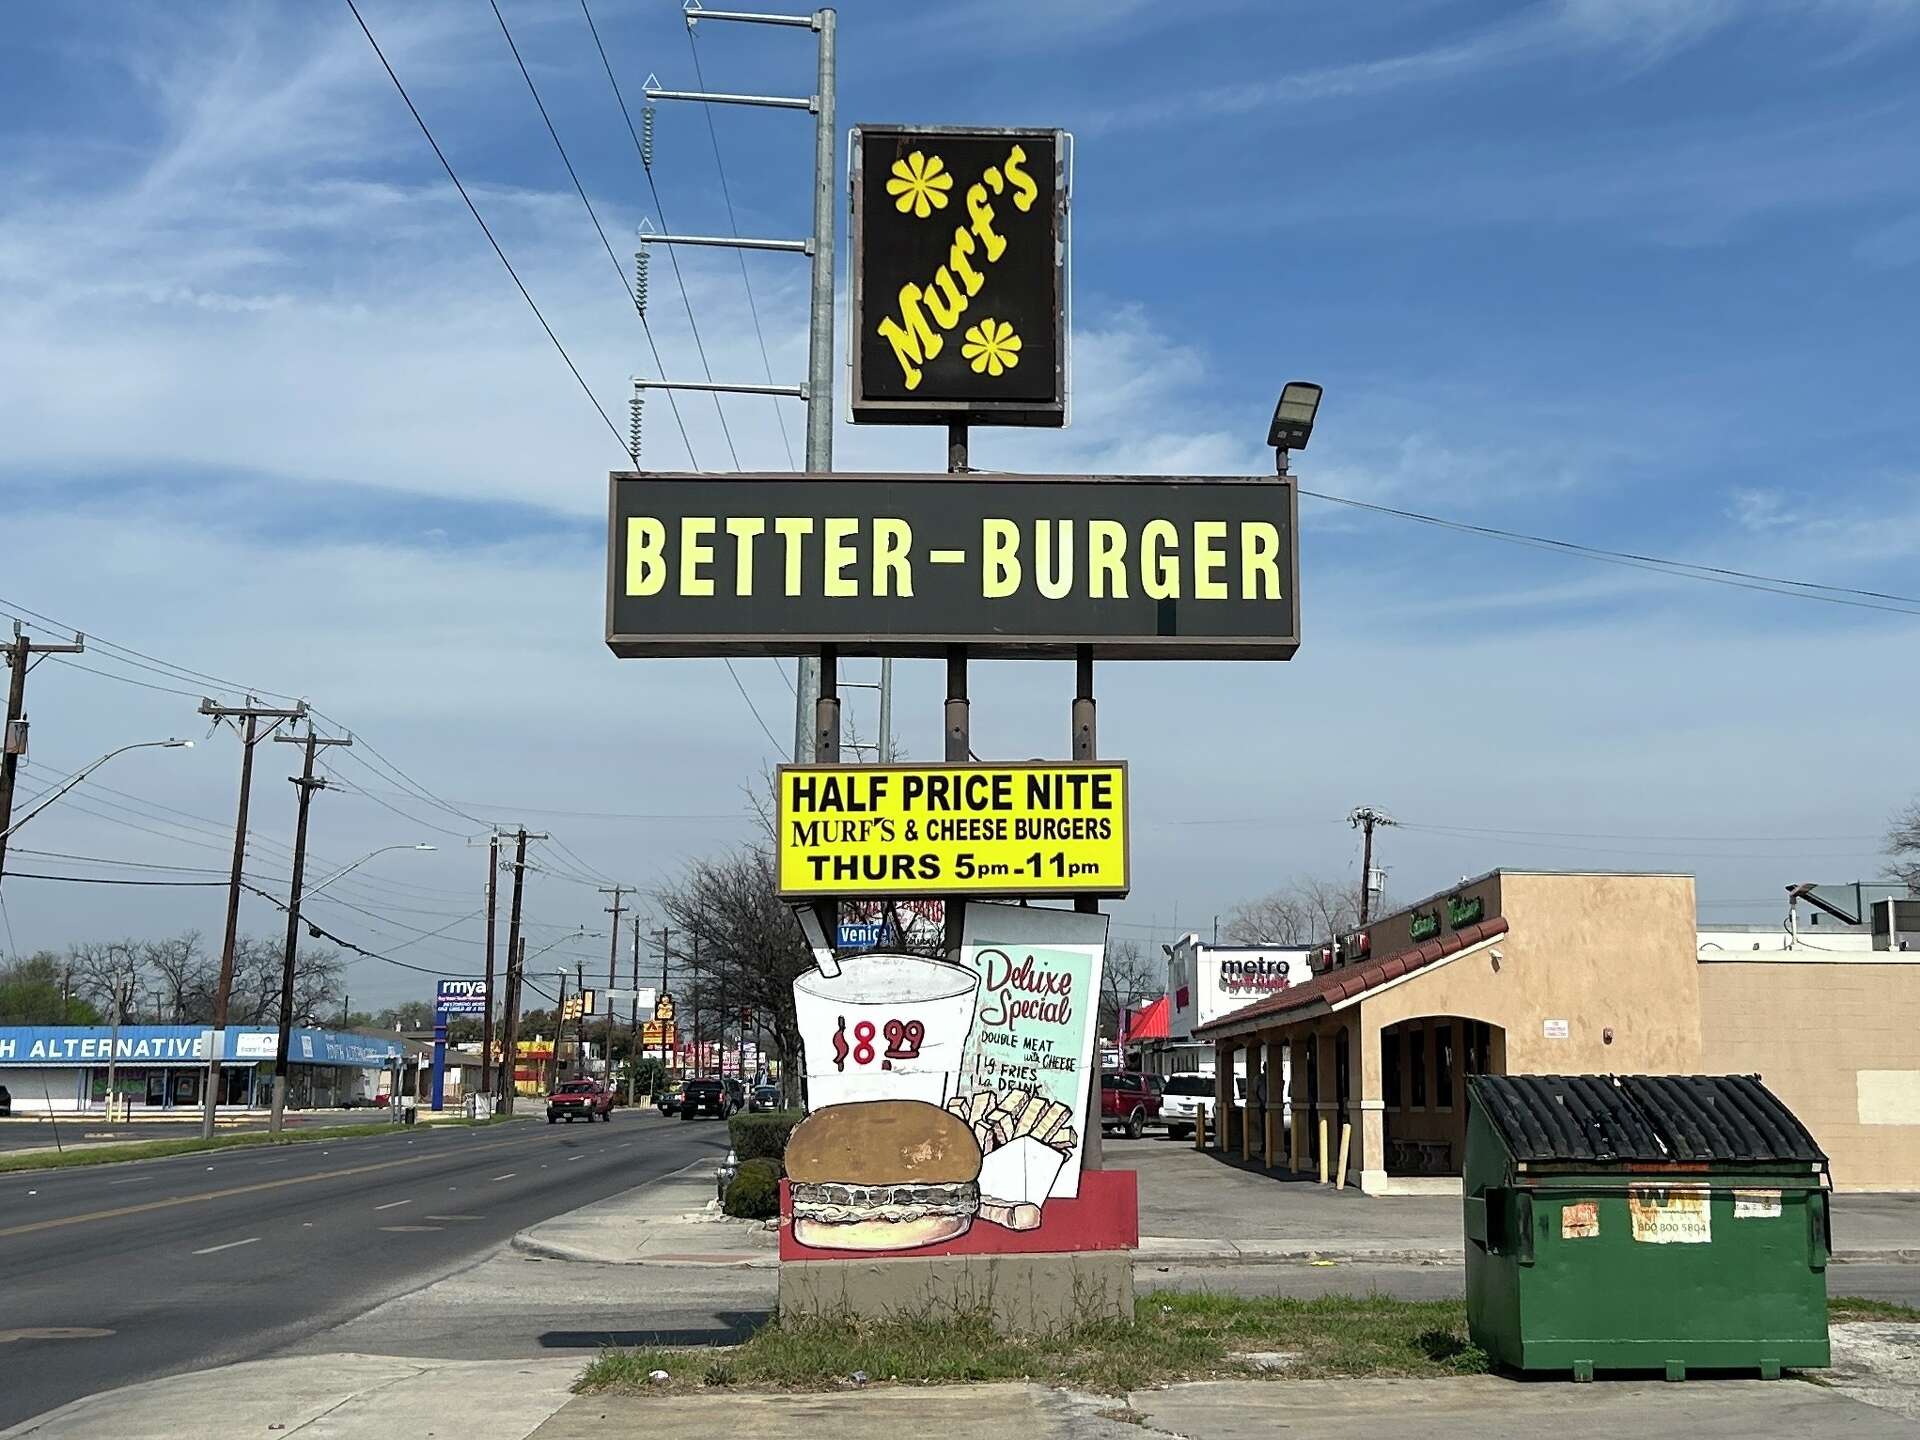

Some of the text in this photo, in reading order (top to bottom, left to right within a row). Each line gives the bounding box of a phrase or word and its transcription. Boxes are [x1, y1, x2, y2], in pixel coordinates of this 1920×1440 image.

[877, 144, 1038, 390] Murf's
[792, 773, 1112, 812] HALF PRICE NITE
[790, 817, 1112, 847] MURF'S & CHEESE BURGERS
[807, 854, 941, 880] THURS
[975, 949, 1072, 997] Deluxe
[1221, 957, 1290, 974] metro
[443, 981, 487, 997] rmya
[980, 988, 1072, 1031] Special
[981, 1030, 1054, 1052] DOUBLE MEAT
[1000, 1063, 1038, 1081] FRIES
[1043, 1054, 1077, 1072] CHEESE
[1659, 1223, 1679, 1232] 800
